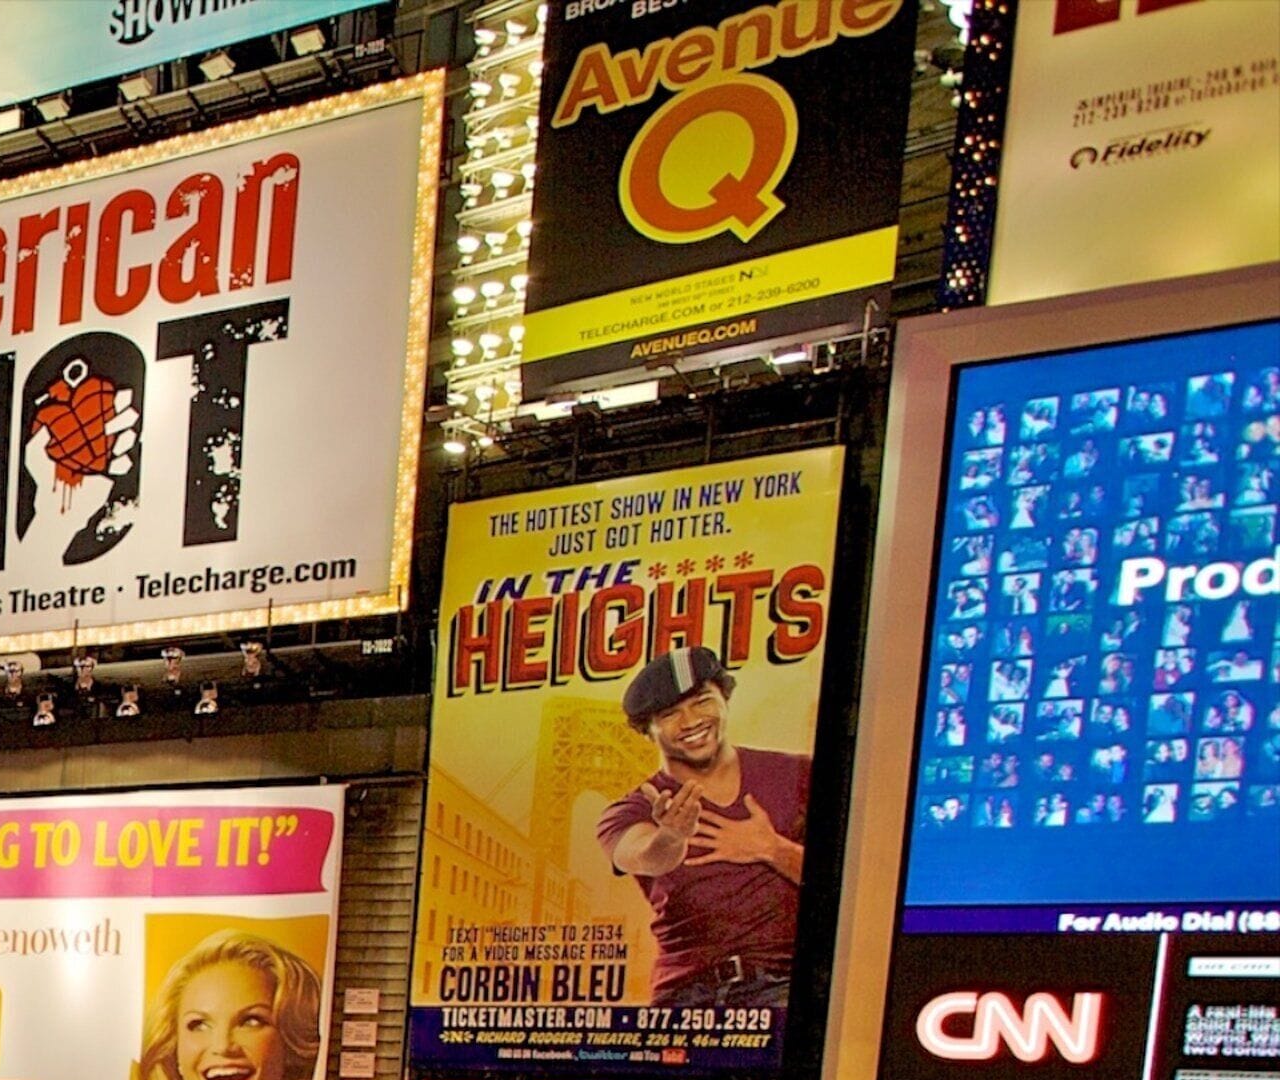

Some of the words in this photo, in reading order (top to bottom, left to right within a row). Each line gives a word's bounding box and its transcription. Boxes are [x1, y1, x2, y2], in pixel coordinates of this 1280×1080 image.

[553, 0, 903, 127] Avenue
[1093, 88, 1142, 108] IMPERIAL
[1147, 76, 1191, 95] THEATRE
[620, 73, 798, 243] Q
[1100, 128, 1213, 163] Fidelity
[655, 283, 692, 301] WORLD
[694, 273, 736, 292] STAGES
[578, 303, 706, 341] TELECHARGE.COM
[709, 300, 723, 313] or
[727, 277, 821, 309] 212-239-6200
[629, 319, 758, 360] AVENUEQ.COM
[489, 510, 519, 538] THE
[525, 500, 605, 532] HOTTEST
[610, 491, 667, 520] SHOW
[672, 487, 692, 511] IN
[698, 479, 745, 509] NEW
[753, 470, 804, 502] YORK
[548, 528, 597, 557] JUST
[605, 522, 642, 550] GOT
[650, 511, 732, 543] HOTTER.
[8, 583, 107, 615] Theatre
[135, 557, 358, 600] Telecharge.com
[475, 569, 533, 604] IN
[545, 559, 643, 599] THE
[448, 564, 827, 698] HEIGHTS
[29, 819, 82, 869] TO
[92, 817, 203, 869] LOVE
[449, 926, 481, 944] TEXT
[560, 925, 577, 942] TO
[582, 924, 624, 942] 21534
[1057, 912, 1102, 932] For
[1101, 911, 1180, 931] Audio
[1181, 911, 1237, 931] Dial
[442, 945, 465, 961] FOR
[470, 945, 478, 961] A
[483, 944, 519, 961] VIDEO
[524, 944, 586, 960] MESSAGE
[590, 943, 628, 960] FROM
[439, 964, 541, 1003] CORBIN
[550, 964, 627, 1003] BLEU
[441, 1006, 613, 1030] TICKETMASTER.COM
[636, 1007, 773, 1031] 877.250.2929
[475, 1031, 527, 1045] RICHARD
[528, 1032, 584, 1046] RODGERS
[586, 1032, 643, 1048] THEATRE,
[646, 1033, 670, 1047] 226
[672, 1033, 689, 1048] W.
[721, 1034, 773, 1048] STREET
[916, 991, 1103, 1065] CNN
